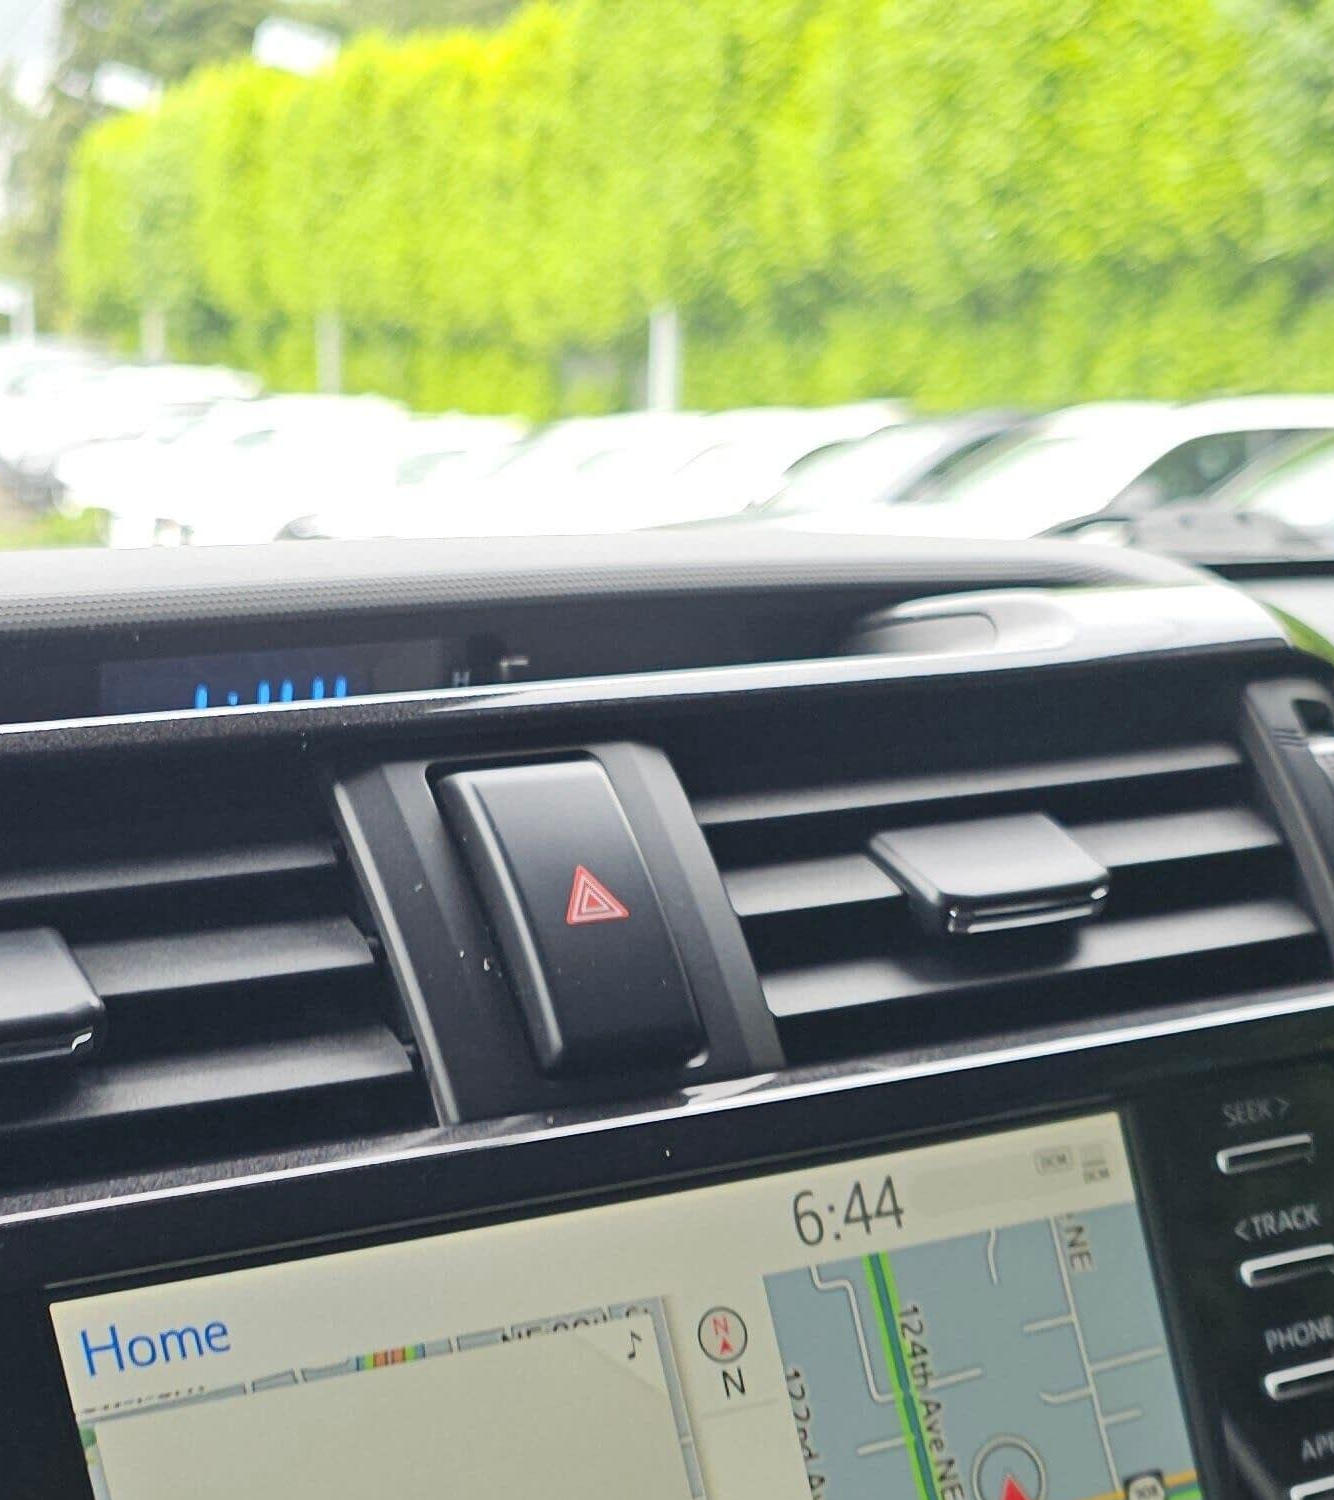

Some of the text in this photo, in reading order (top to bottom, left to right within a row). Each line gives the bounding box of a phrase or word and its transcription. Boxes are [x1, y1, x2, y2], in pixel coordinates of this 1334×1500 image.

[793, 1176, 904, 1247] 6:44
[1064, 1225, 1093, 1272] NE
[80, 1320, 231, 1377] Home
[722, 1366, 746, 1399] N
[899, 1304, 935, 1388] 124th
[919, 1400, 945, 1452] Ave
